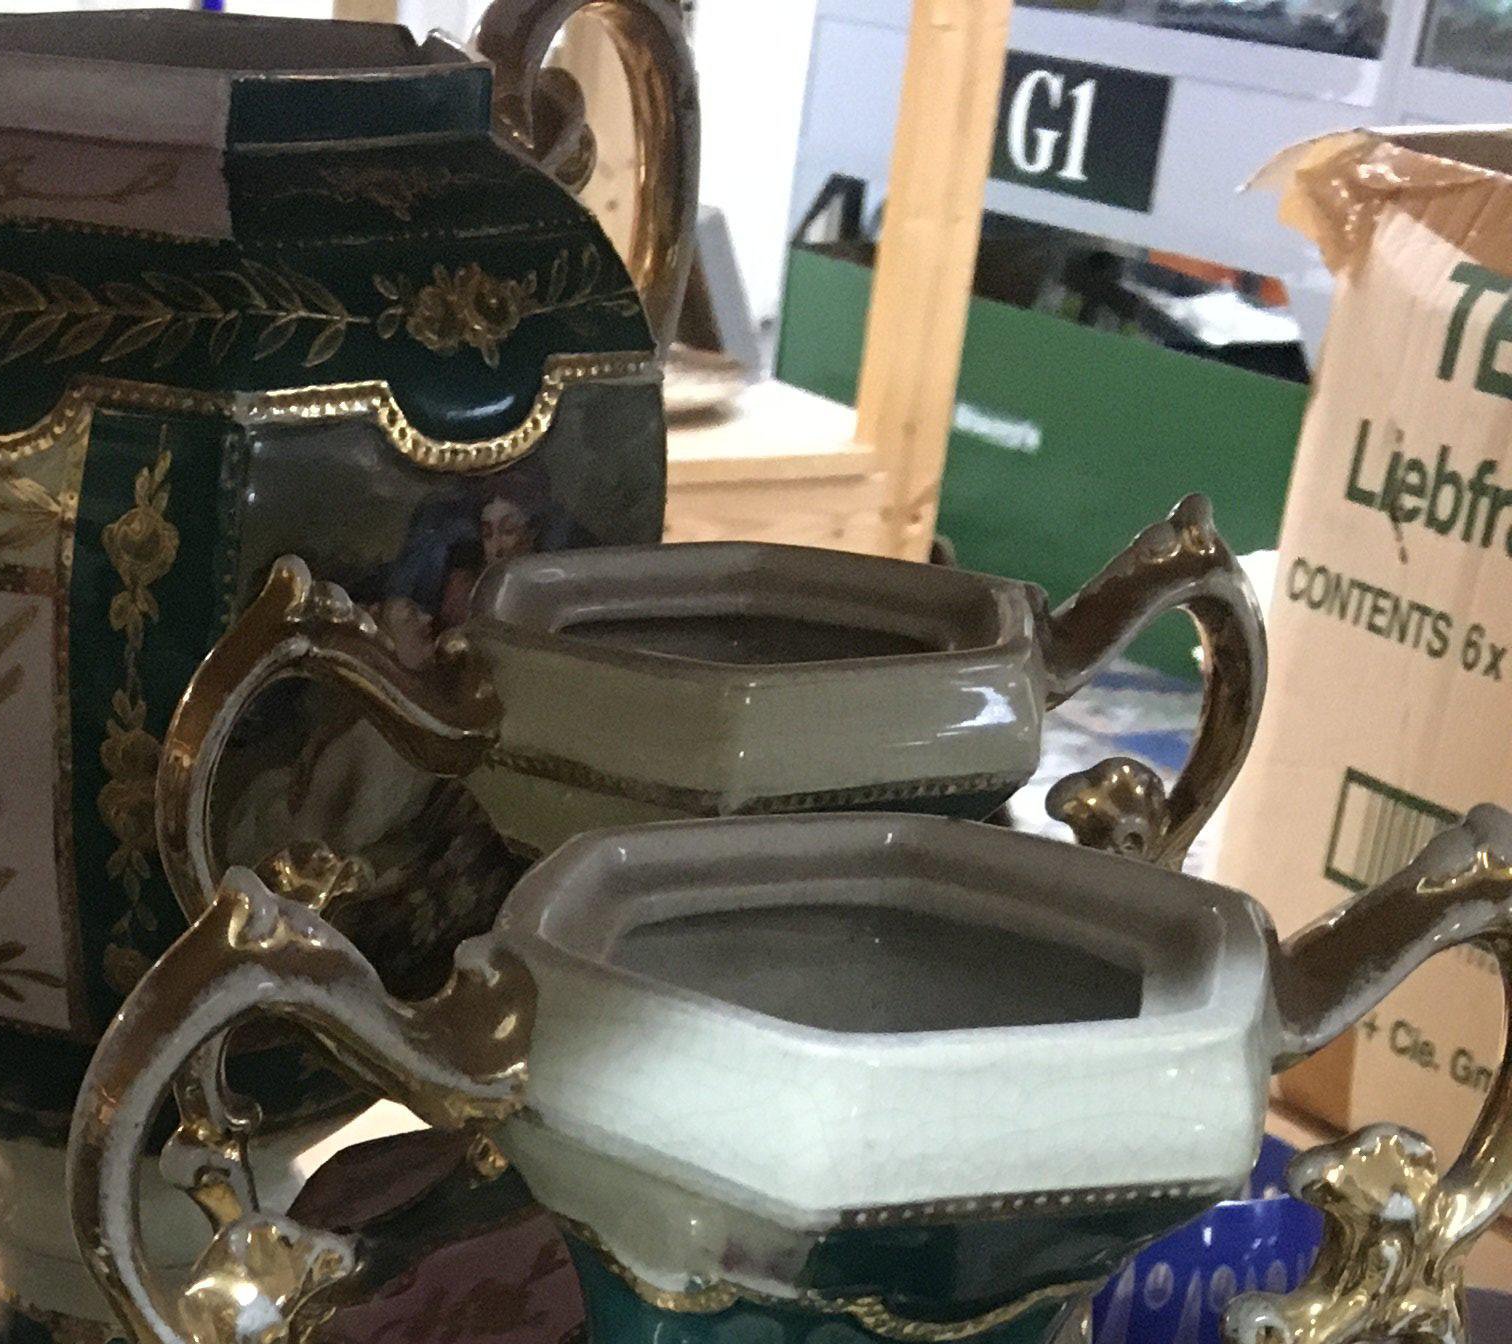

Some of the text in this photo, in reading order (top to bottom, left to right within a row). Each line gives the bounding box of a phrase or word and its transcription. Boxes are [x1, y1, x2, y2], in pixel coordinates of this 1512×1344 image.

[1007, 69, 1097, 181] G1
[1345, 418, 1512, 558] Liebfr
[1287, 556, 1454, 660] CONTENTS
